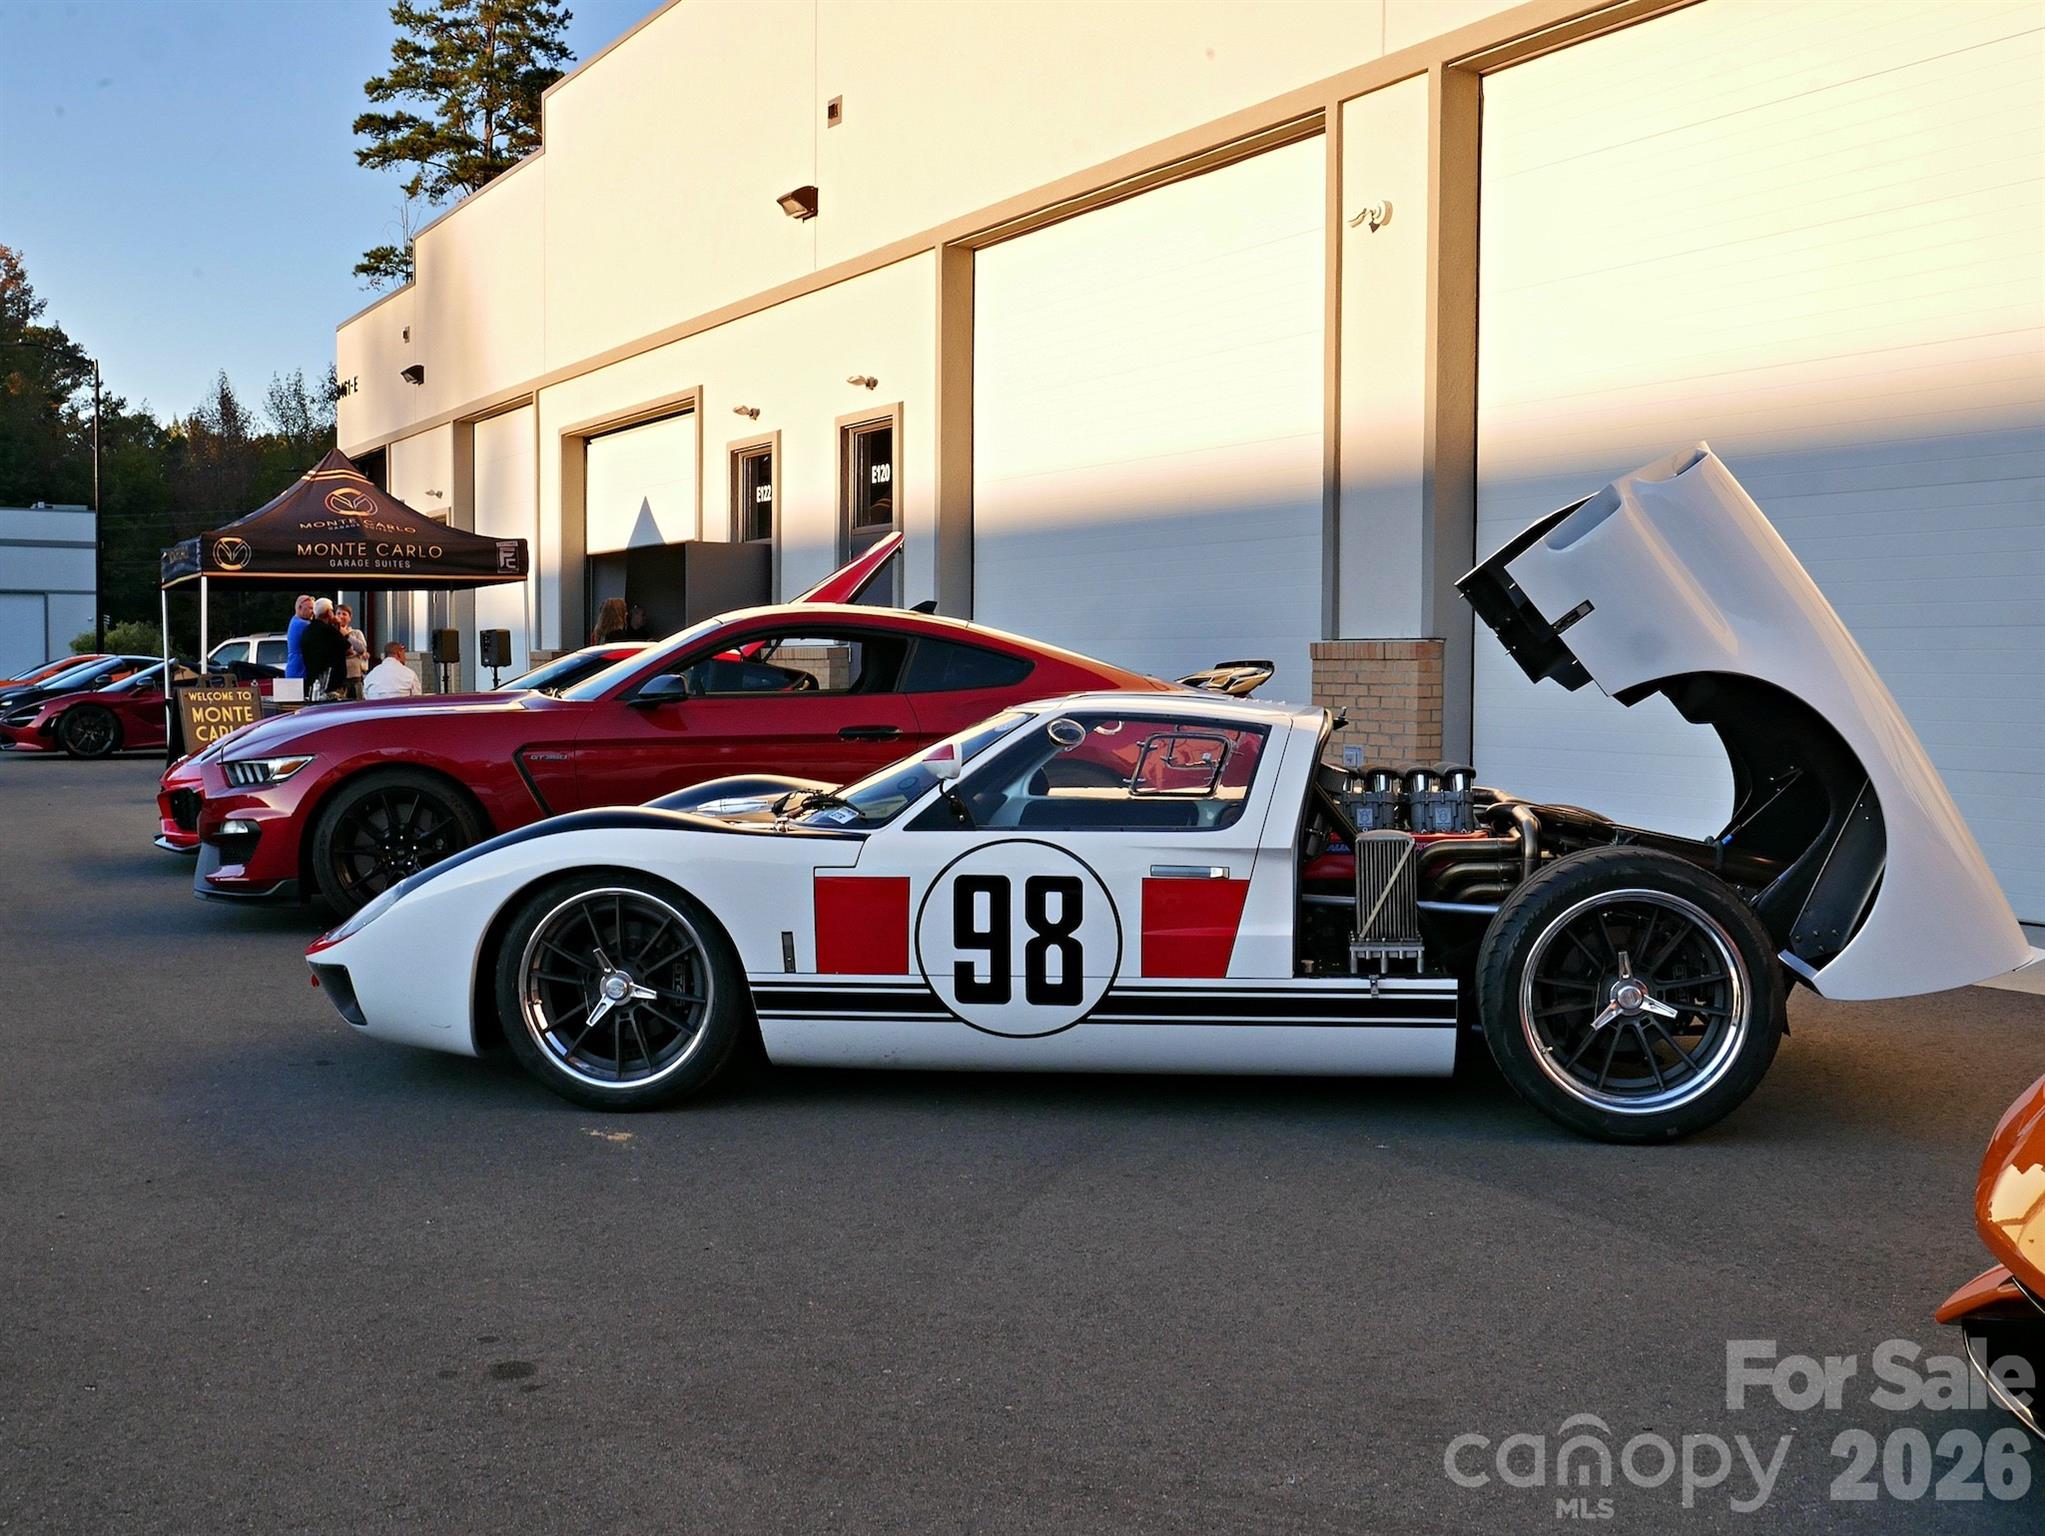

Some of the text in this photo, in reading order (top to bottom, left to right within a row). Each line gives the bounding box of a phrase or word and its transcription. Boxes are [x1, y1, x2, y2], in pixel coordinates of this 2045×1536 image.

[872, 463, 890, 484] E120
[756, 484, 772, 503] E122
[299, 518, 417, 534] MONTE CARLO
[297, 542, 443, 559] MONTE CARLO
[329, 559, 411, 568] GARAGE SUITES
[188, 691, 252, 701] WELCOME TO
[192, 706, 254, 722] MONTE
[953, 874, 1084, 1006] 98
